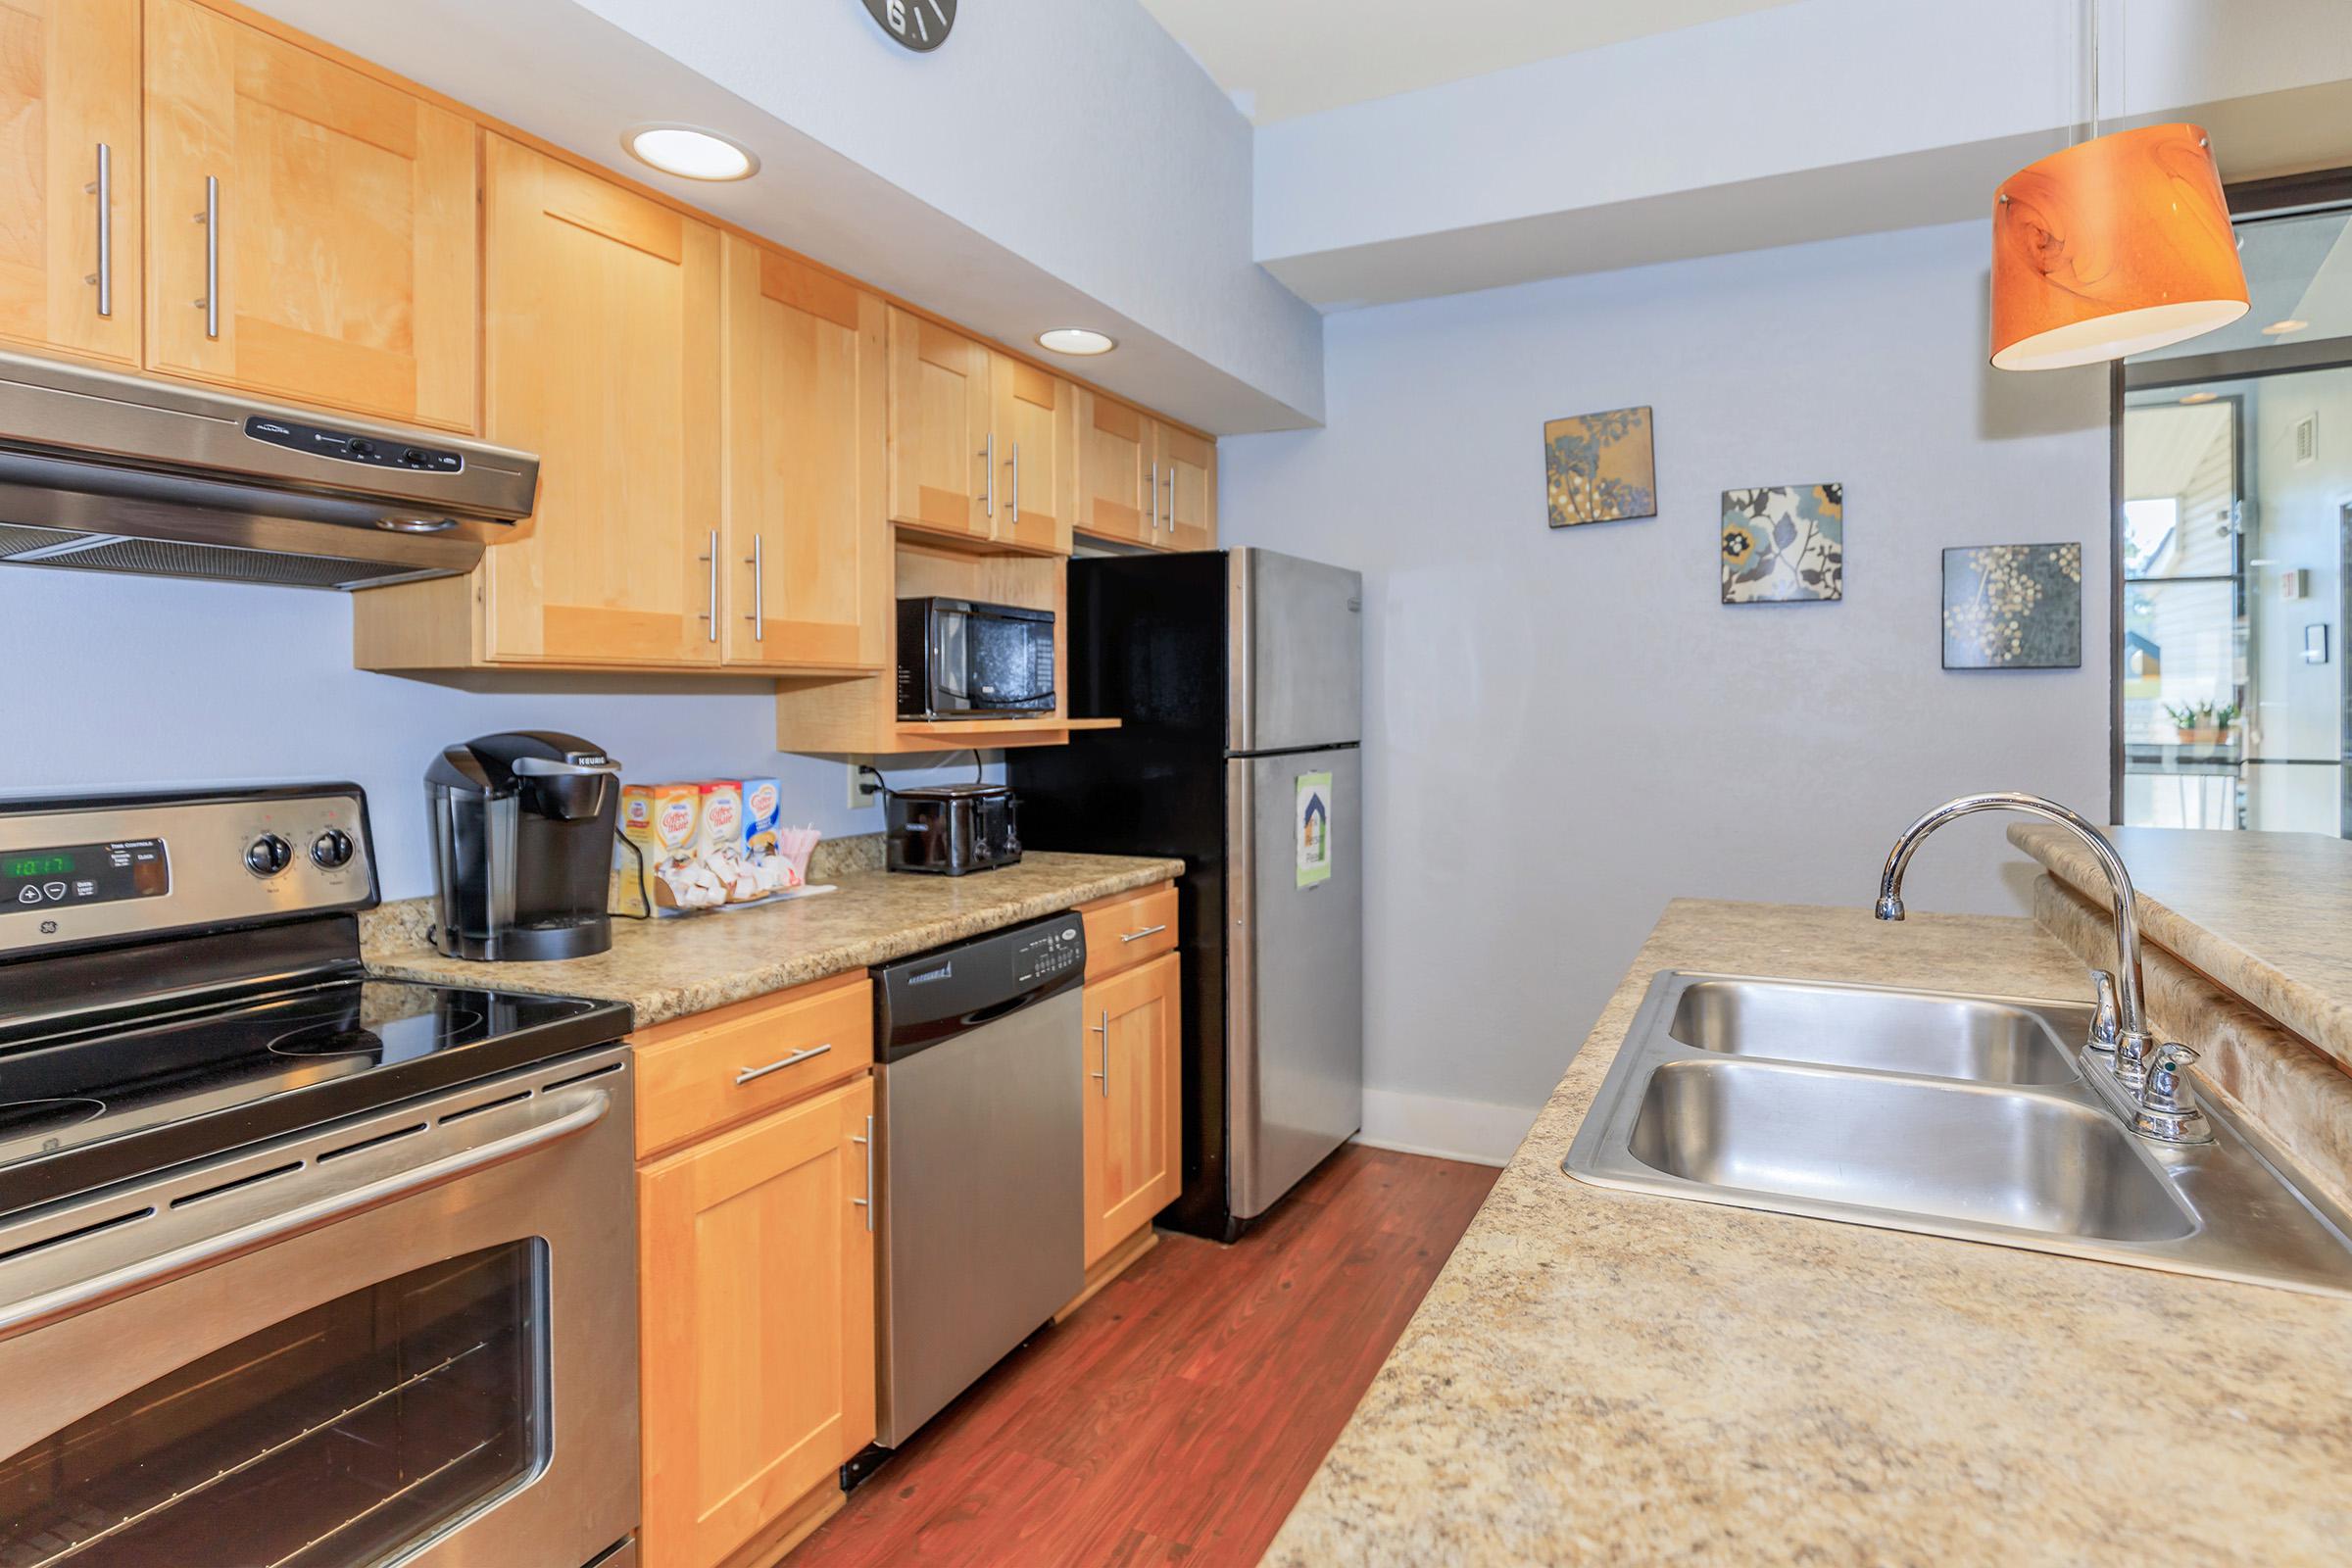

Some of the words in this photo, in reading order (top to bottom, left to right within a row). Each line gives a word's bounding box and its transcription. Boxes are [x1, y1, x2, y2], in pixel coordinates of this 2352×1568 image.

[886, 0, 906, 35] 6
[578, 757, 605, 765] KEURIG
[662, 810, 690, 828] Coffee
[710, 806, 733, 821] Coffee
[713, 813, 733, 828] mate
[667, 820, 689, 833] mate
